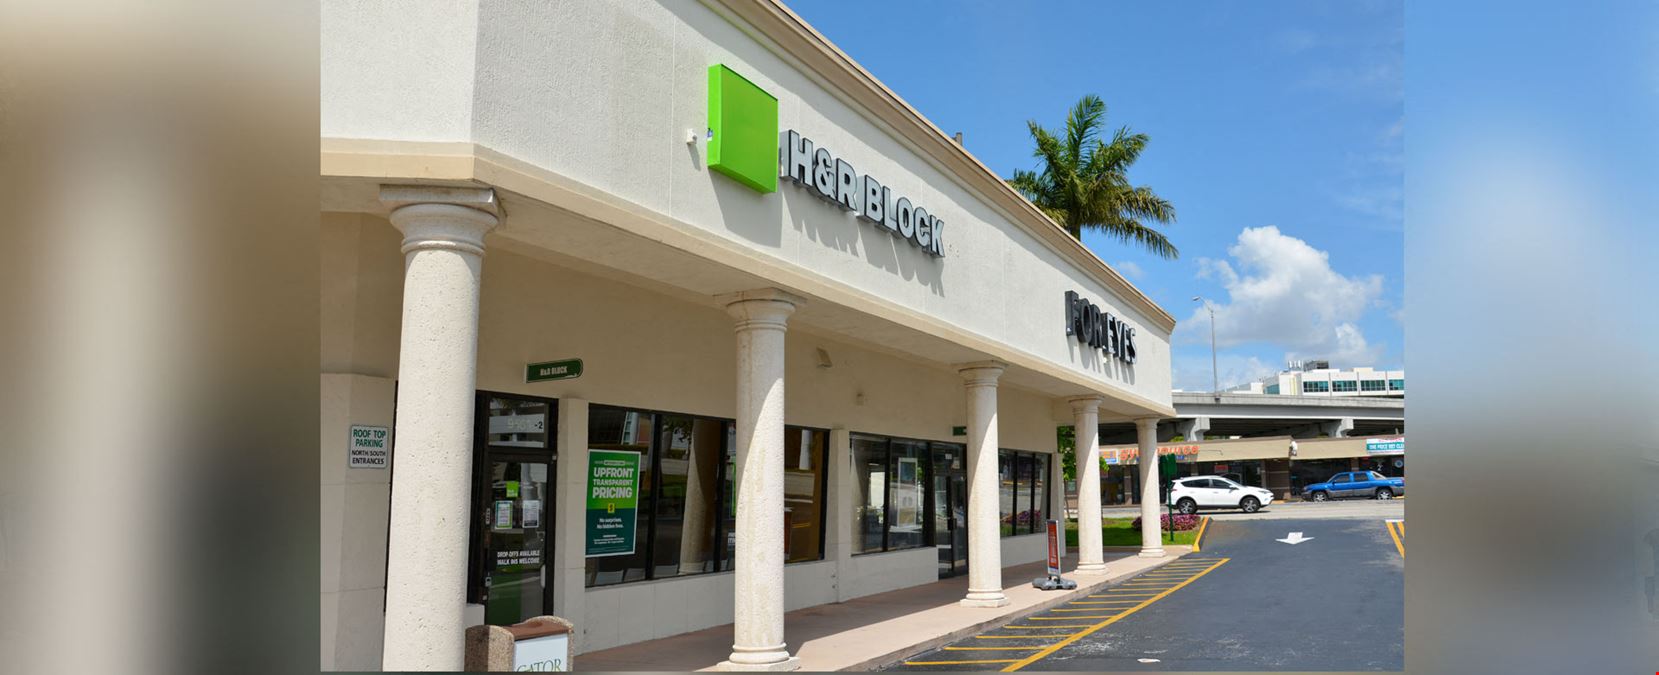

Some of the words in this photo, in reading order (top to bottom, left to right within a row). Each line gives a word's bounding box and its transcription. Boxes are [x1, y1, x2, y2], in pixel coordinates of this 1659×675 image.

[779, 129, 858, 212] H&R
[856, 174, 945, 258] BLOCK
[1065, 290, 1103, 349] FOR
[1101, 312, 1138, 364] EYES
[352, 429, 371, 438] ROOF
[373, 430, 386, 439] TOP
[355, 438, 383, 448] PARKING
[352, 457, 385, 465] ENTRANCES
[593, 467, 634, 478] UPFRONT
[592, 486, 633, 498] PRICING
